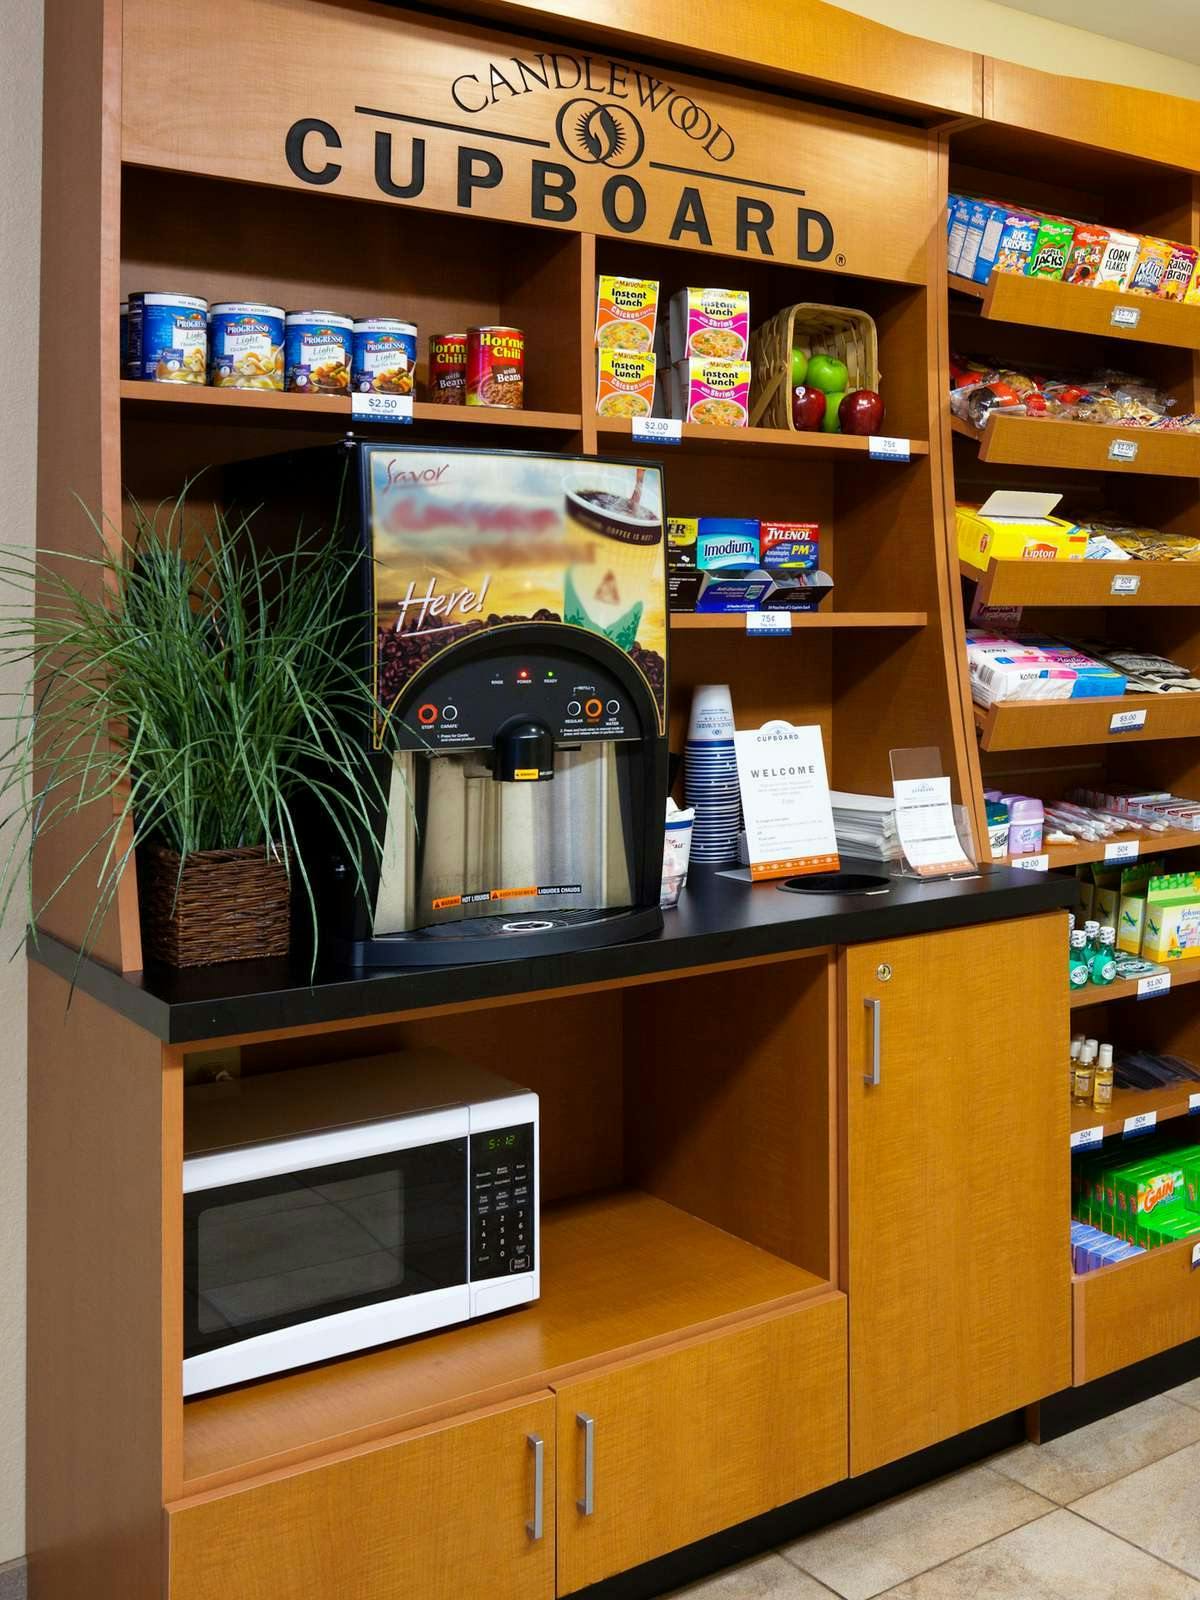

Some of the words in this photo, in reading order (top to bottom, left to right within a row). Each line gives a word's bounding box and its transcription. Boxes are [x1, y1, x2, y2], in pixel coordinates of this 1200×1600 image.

[451, 53, 735, 162] CANDLEWOOD
[1011, 229, 1028, 240] RICE
[1001, 238, 1033, 251] KRISPIES
[1108, 248, 1130, 262] CORN
[1032, 254, 1064, 273] JACKS
[1105, 261, 1127, 272] FLAKES
[1168, 258, 1193, 274] Raisin
[1166, 269, 1188, 282] Bran
[611, 288, 647, 300] Instant
[615, 297, 642, 307] Lunch
[611, 306, 640, 320] Chicken
[705, 307, 733, 317] Lunch
[708, 318, 734, 328] Shrimp
[227, 325, 269, 335] PROGRESSO
[235, 335, 259, 346] Light
[304, 336, 343, 345] PROGRESSO
[367, 343, 405, 352] PROGRESSO
[492, 346, 521, 360] Chili
[503, 367, 517, 375] with
[611, 360, 645, 371] Instant
[496, 373, 521, 383] Beans
[615, 369, 641, 379] Lunch
[703, 369, 739, 379] Instant
[706, 377, 735, 387] Lunch
[709, 389, 735, 399] Shrimp
[368, 398, 397, 409] $2.50
[645, 421, 669, 431] $2.00
[383, 459, 450, 494] Savor
[767, 527, 812, 541] TYLENOL
[704, 541, 751, 557] Imodium
[791, 545, 809, 556] PM
[1024, 547, 1056, 560] Lipton
[396, 574, 492, 634] Here!
[761, 615, 775, 623] 75¢
[757, 733, 799, 743] CUPBOARD
[750, 765, 816, 779] WELCOME
[1021, 859, 1040, 868] $2.00
[538, 887, 560, 895] LIQUIDES
[561, 886, 581, 894] CHAUDS
[488, 1135, 515, 1150] 5:12
